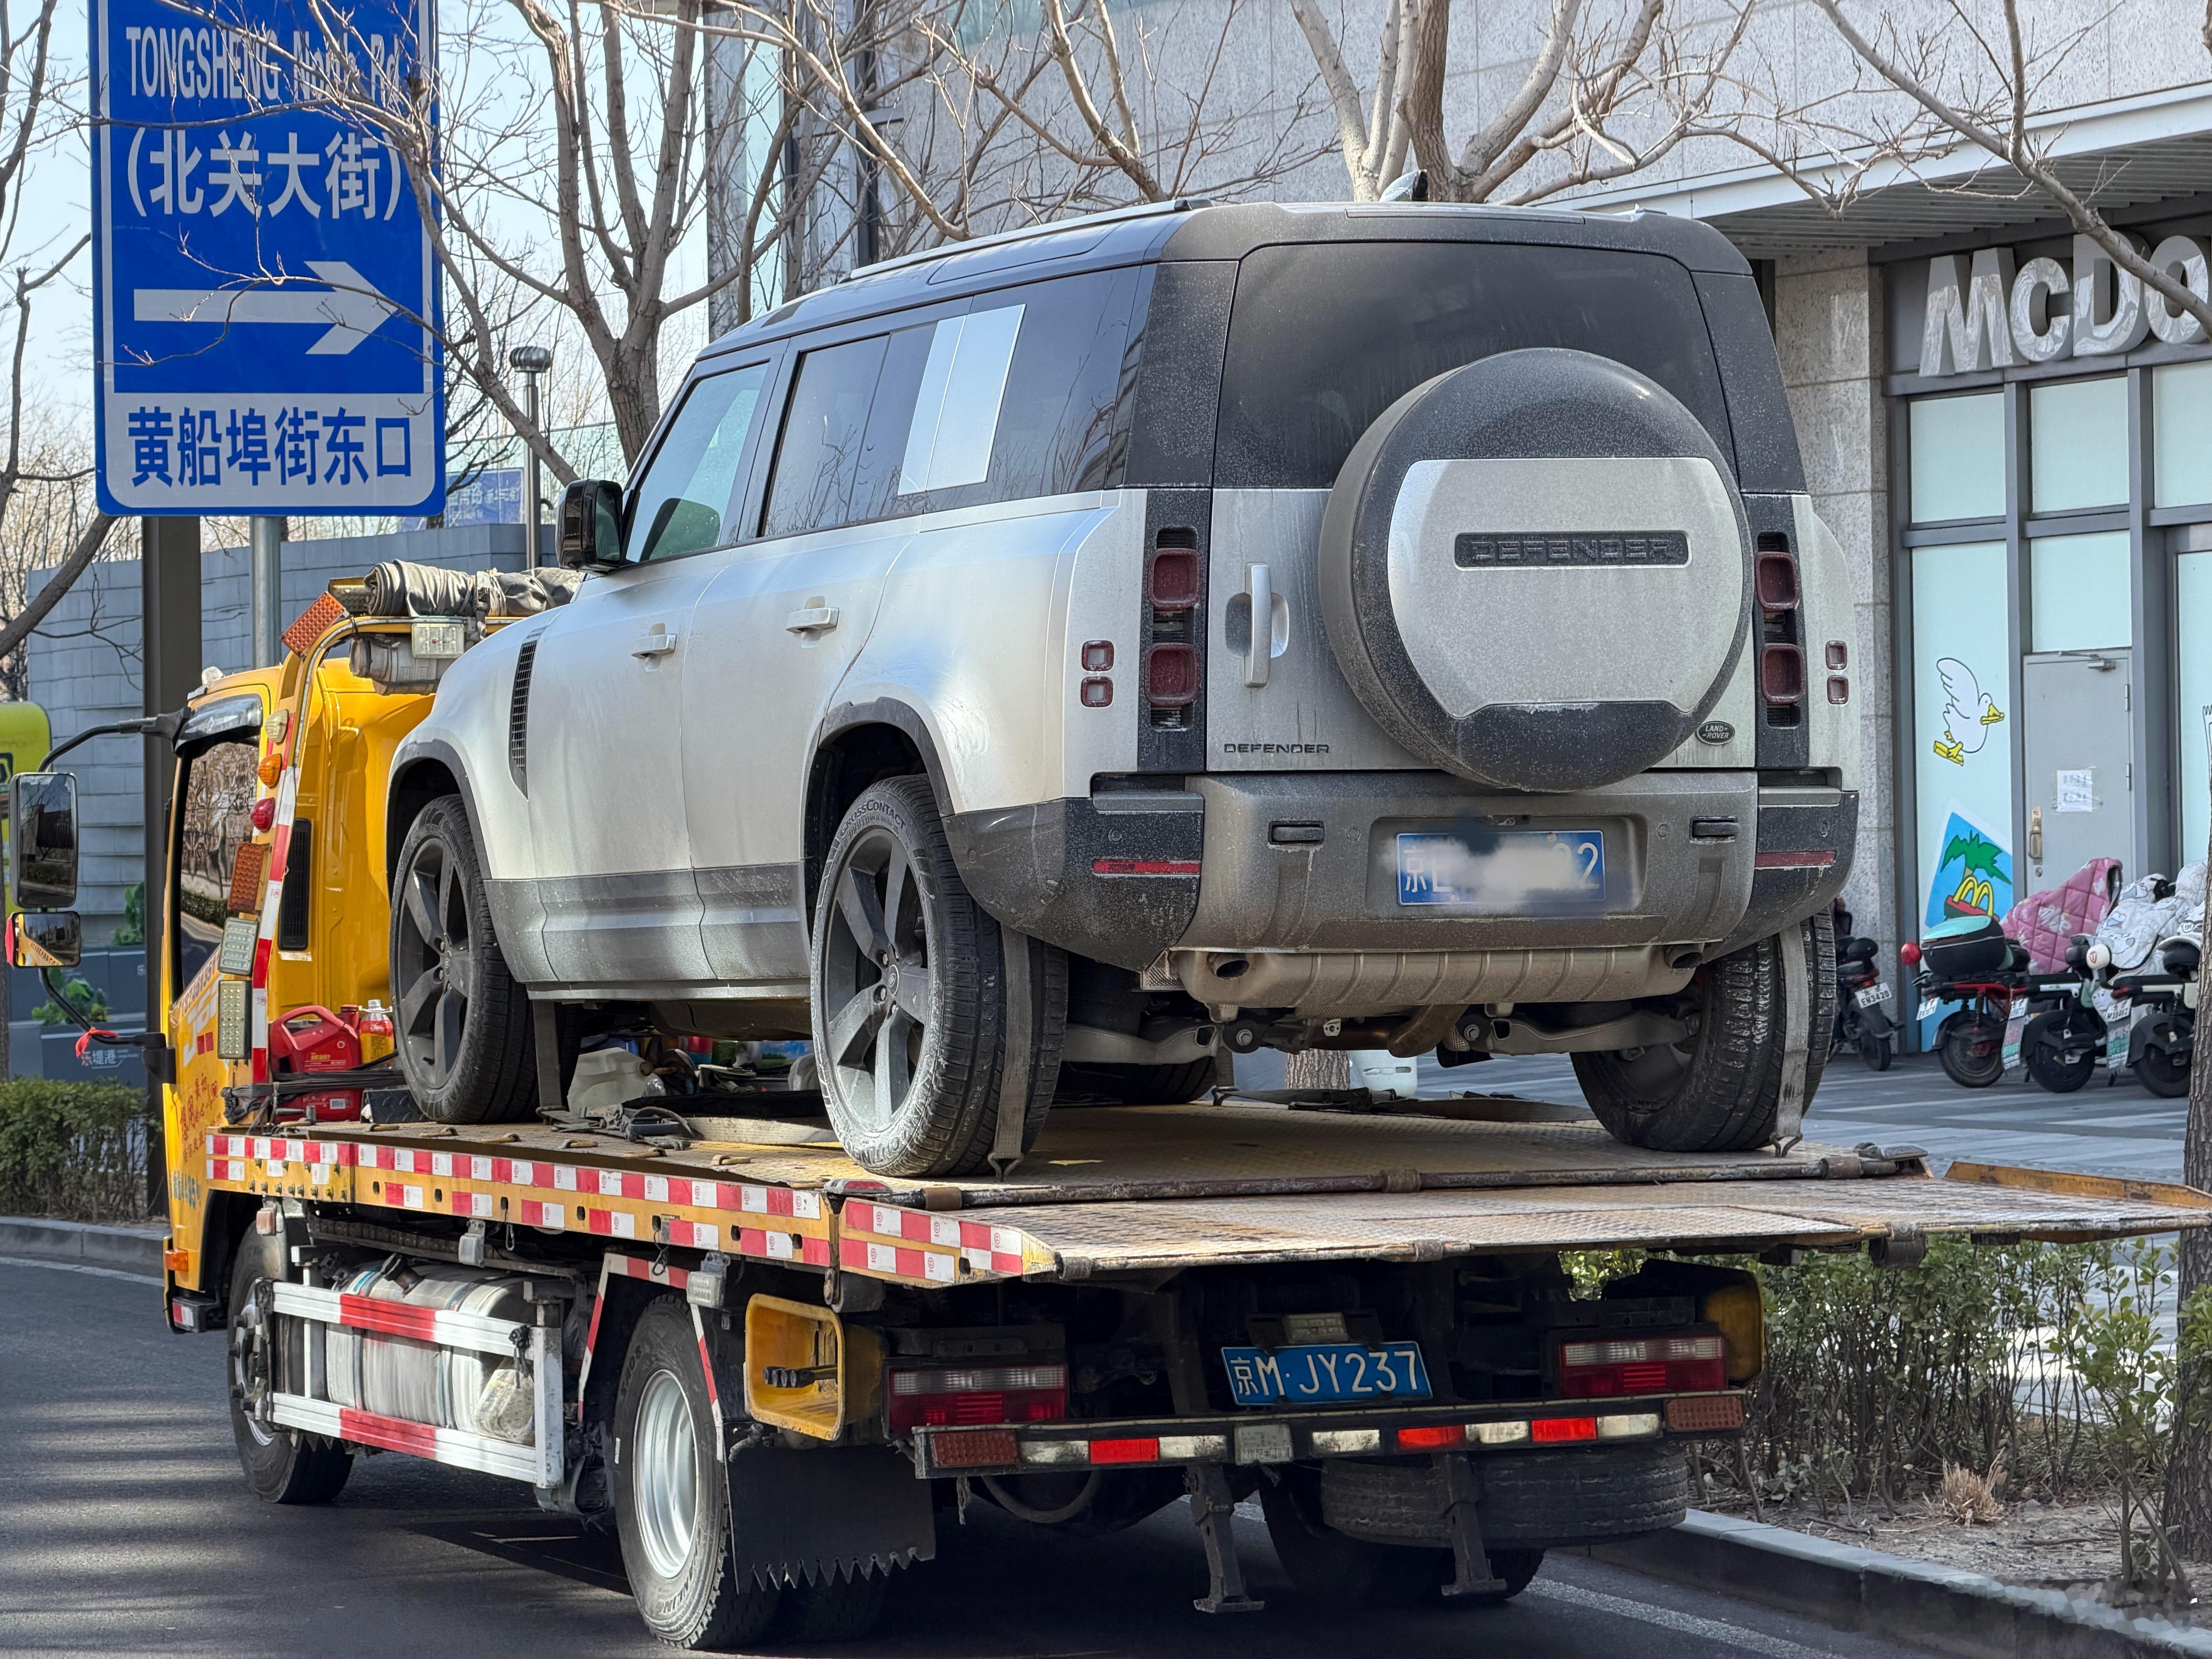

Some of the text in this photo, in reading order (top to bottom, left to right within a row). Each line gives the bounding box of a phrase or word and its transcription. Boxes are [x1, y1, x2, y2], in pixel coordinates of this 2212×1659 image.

[126, 26, 278, 100] TONGSHENG
[128, 127, 401, 221] (北关大街)
[128, 406, 412, 488] 黄船埠街东口
[1472, 539, 1675, 561] DEFENDER
[1224, 743, 1329, 754] DEFENDER
[1230, 1350, 1417, 1396] 京M·JY237
